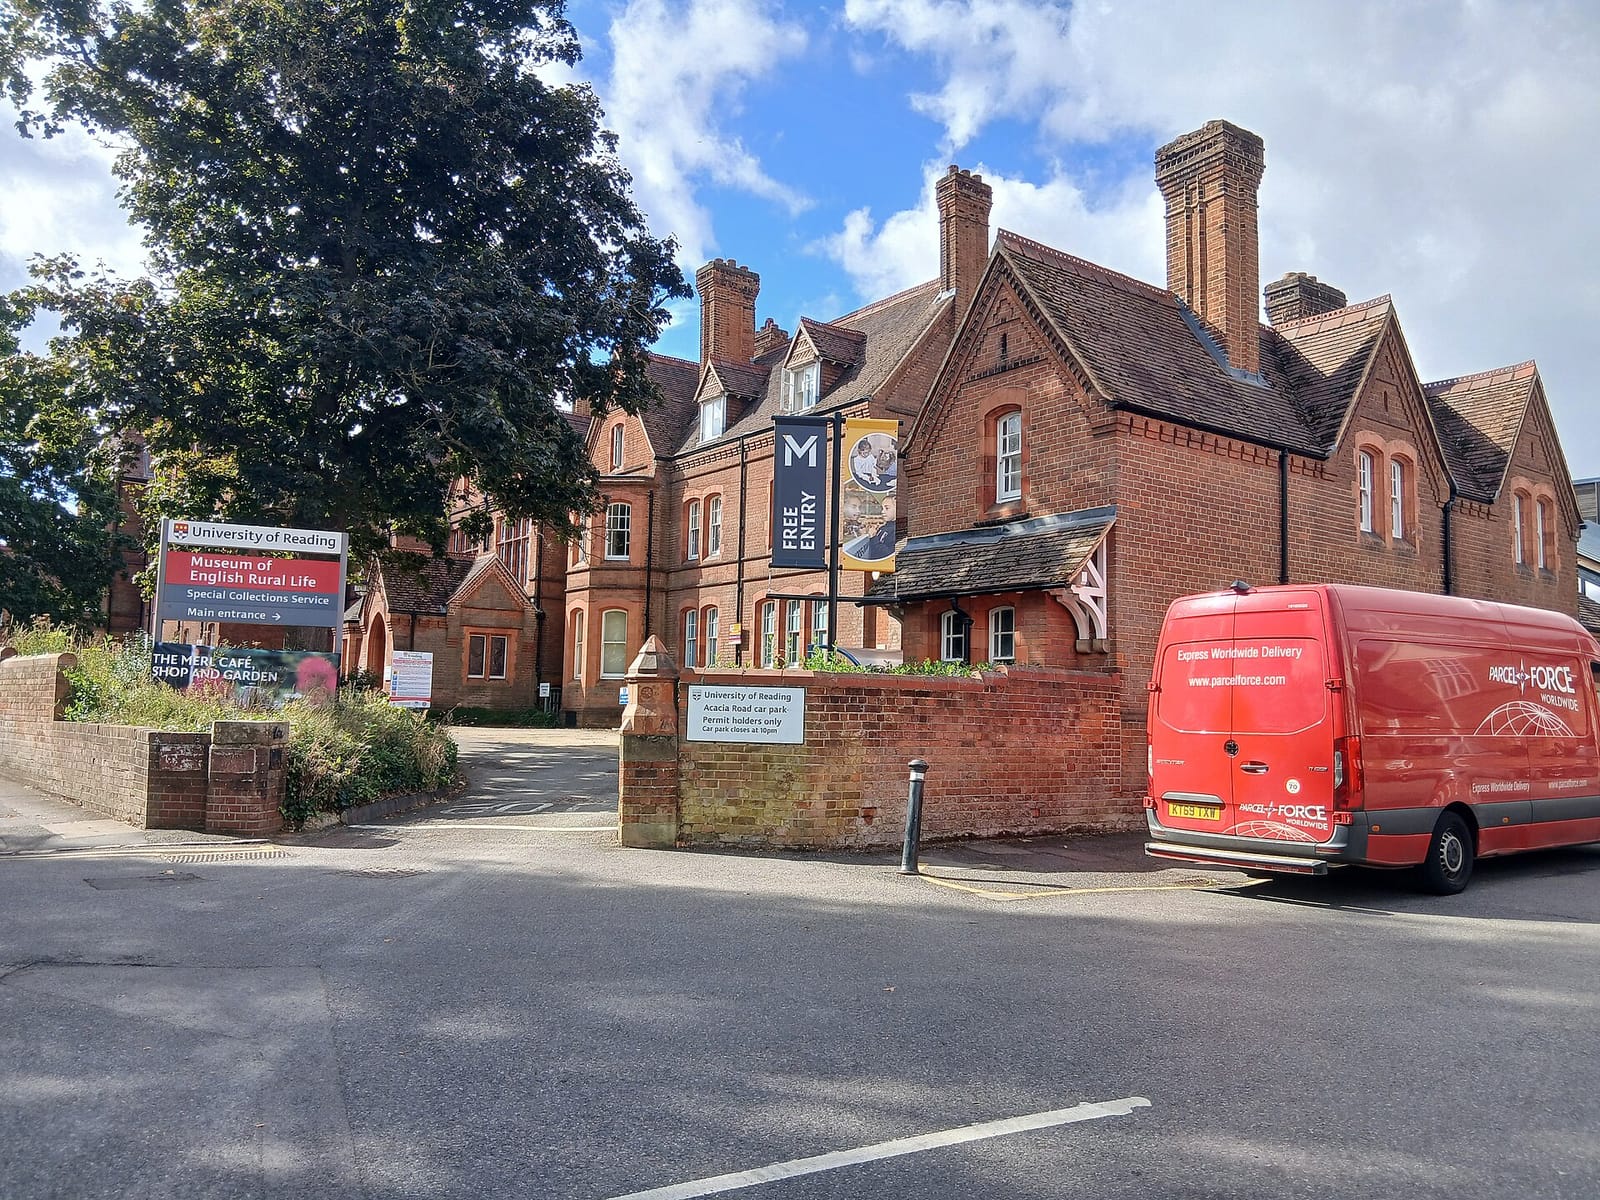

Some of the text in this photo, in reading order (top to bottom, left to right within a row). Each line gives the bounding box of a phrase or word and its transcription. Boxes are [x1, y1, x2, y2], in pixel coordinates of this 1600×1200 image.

[800, 490, 816, 550] ENTRY
[782, 506, 799, 550] FREE
[192, 526, 336, 549] University of Reading
[191, 556, 273, 571] Museum of
[190, 570, 317, 588] English Rural Life
[186, 588, 329, 605] Special Collections Service
[187, 607, 266, 620] Main entrance
[153, 653, 179, 665] THE
[181, 655, 217, 667] MERL
[1177, 646, 1303, 662] Express Worldwide Delivery
[151, 665, 279, 682] SHOP AND GARDEN
[1188, 674, 1286, 688] www.parcelforce.com
[1488, 666, 1576, 694] PARCEL FORCE
[704, 691, 792, 702] University of Reading
[1540, 693, 1579, 712] WORLDWIDE
[703, 704, 730, 712] Acacia
[732, 704, 752, 713] Road
[768, 705, 788, 715] park
[702, 716, 782, 728] Permit holders only
[730, 726, 750, 734] closes
[760, 727, 778, 735] 10pm
[1472, 781, 1530, 795] Express Worldwide Delivery
[1239, 803, 1328, 821] PARCEL FORCE
[1285, 818, 1329, 830] WORLDWIDE
